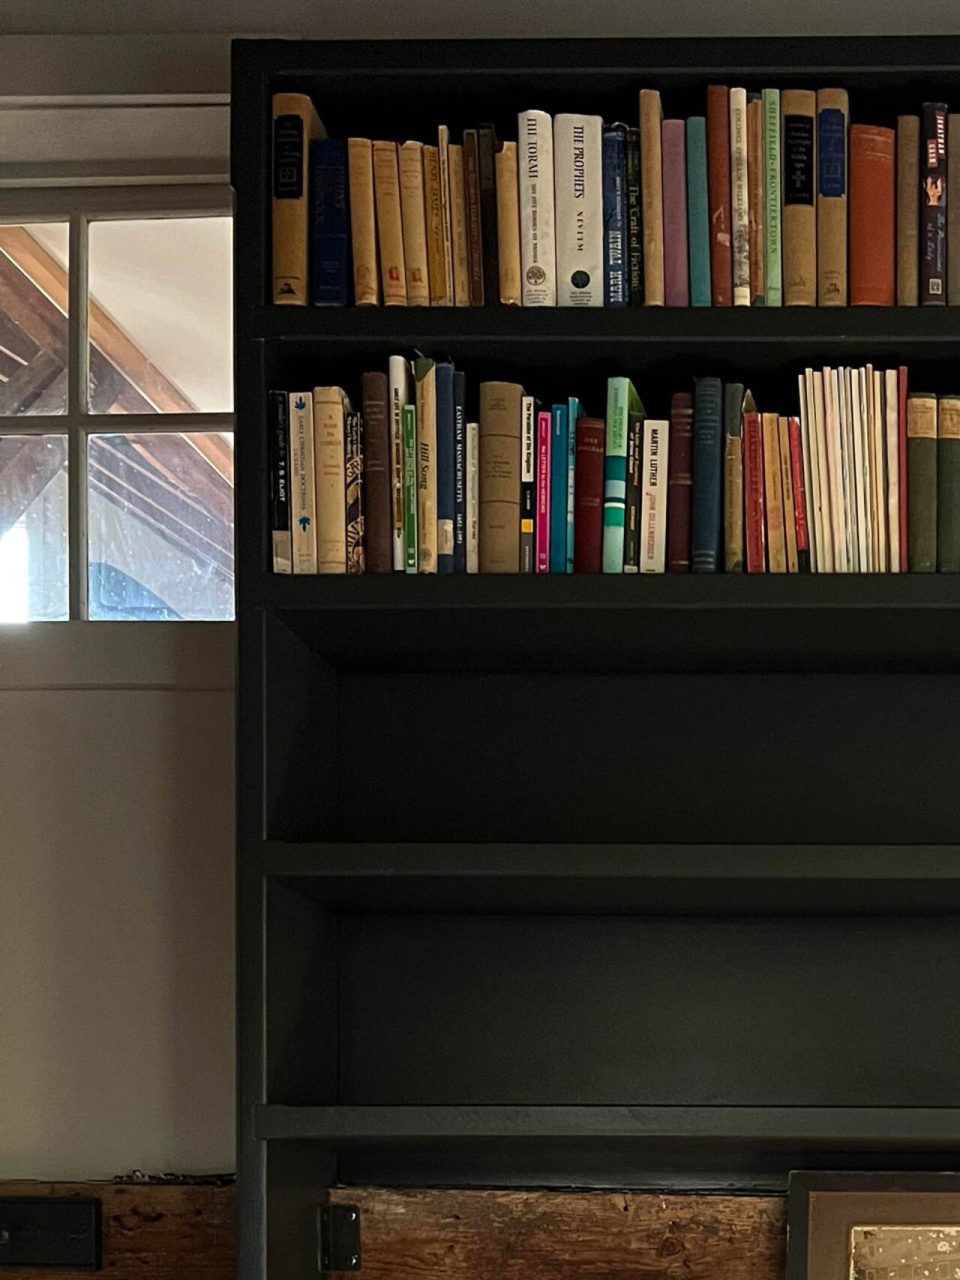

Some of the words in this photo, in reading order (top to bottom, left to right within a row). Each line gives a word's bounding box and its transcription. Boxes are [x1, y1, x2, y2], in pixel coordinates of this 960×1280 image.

[573, 126, 584, 144] THE
[528, 142, 538, 178] TORAH
[574, 147, 584, 198] PROPHETS
[629, 185, 639, 202] The
[630, 204, 639, 234] Craft
[609, 231, 622, 265] TWAIN
[630, 237, 639, 248] of
[631, 252, 639, 288] Fiction
[610, 271, 622, 302] MARK
[421, 442, 429, 463] Hill
[650, 429, 658, 456] MARTIN
[419, 464, 429, 490] Song
[649, 459, 658, 487] LUTHER
